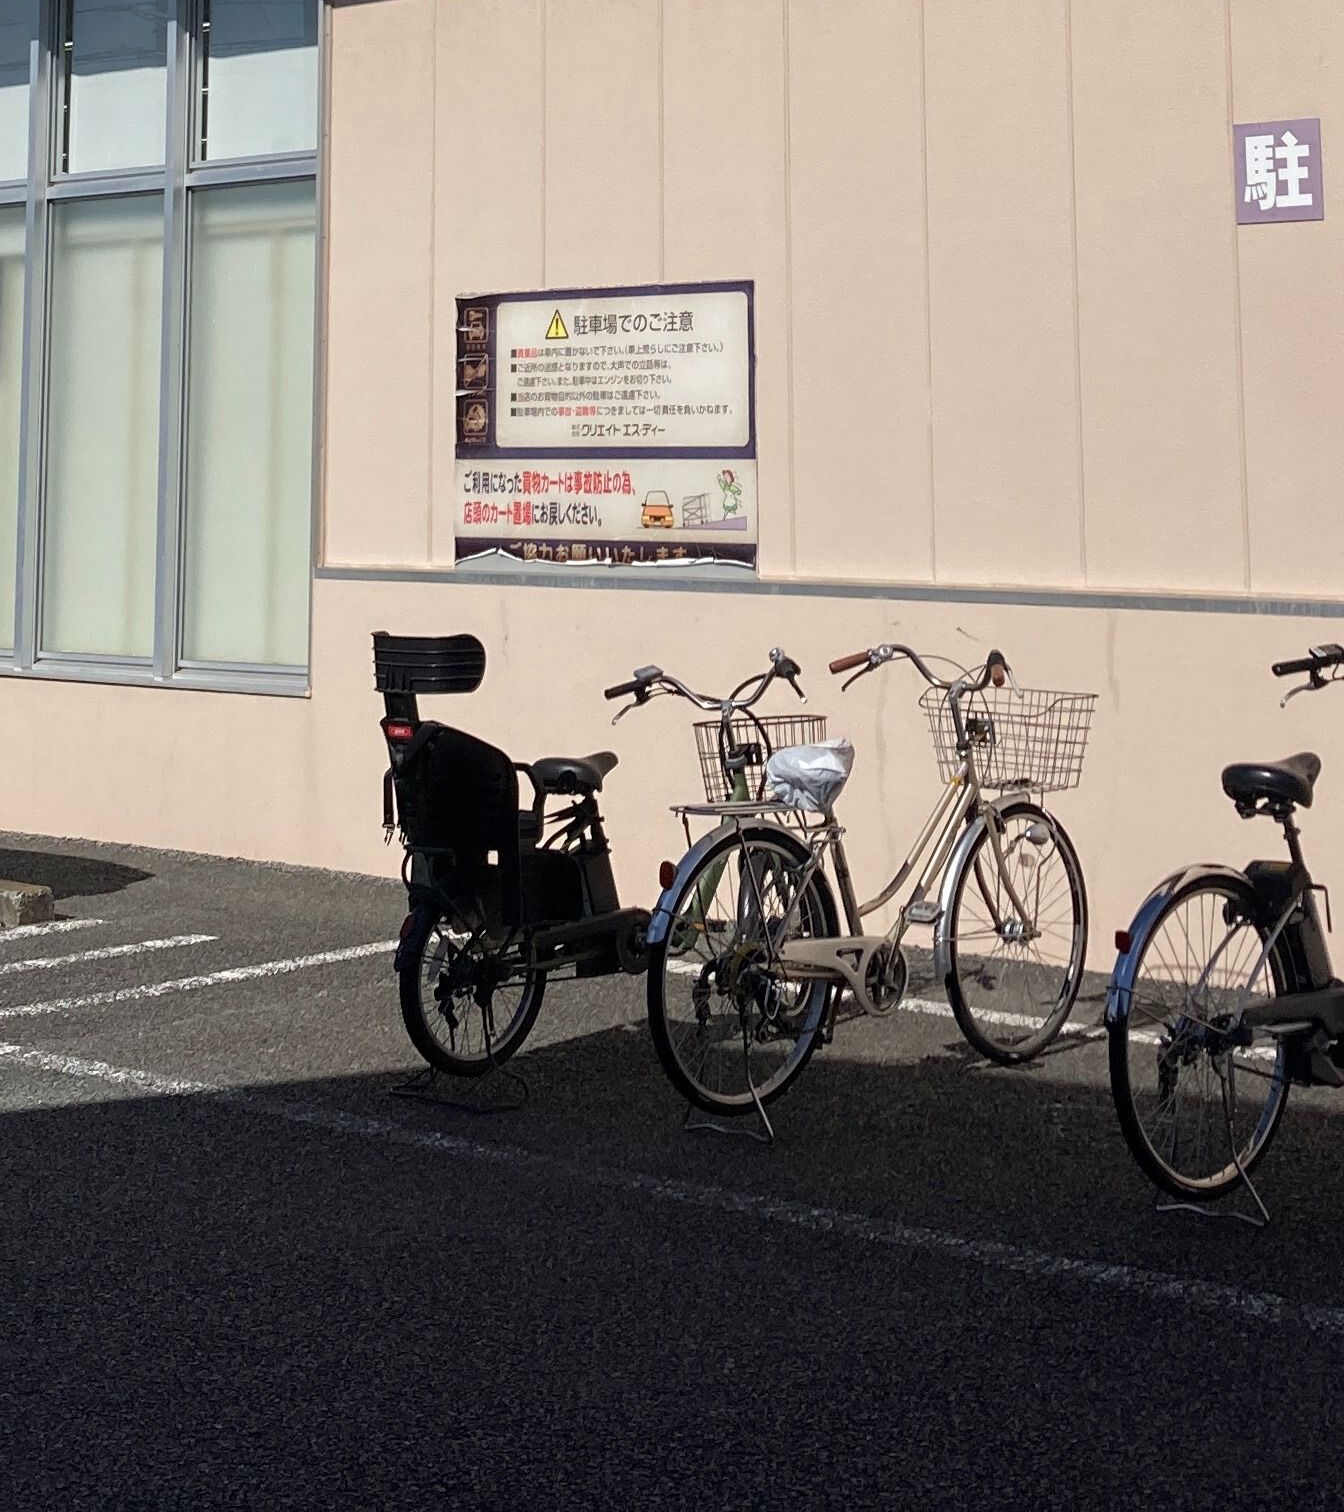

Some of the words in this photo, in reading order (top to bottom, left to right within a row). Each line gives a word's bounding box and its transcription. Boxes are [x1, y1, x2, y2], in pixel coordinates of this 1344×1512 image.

[574, 310, 695, 336] 駐車場でのご注意
[581, 424, 621, 437] クリエイト
[463, 470, 636, 495] ご利用になった買物カートは事故防止の為、
[463, 500, 602, 527] 店頭のカート置場にお戻しください。
